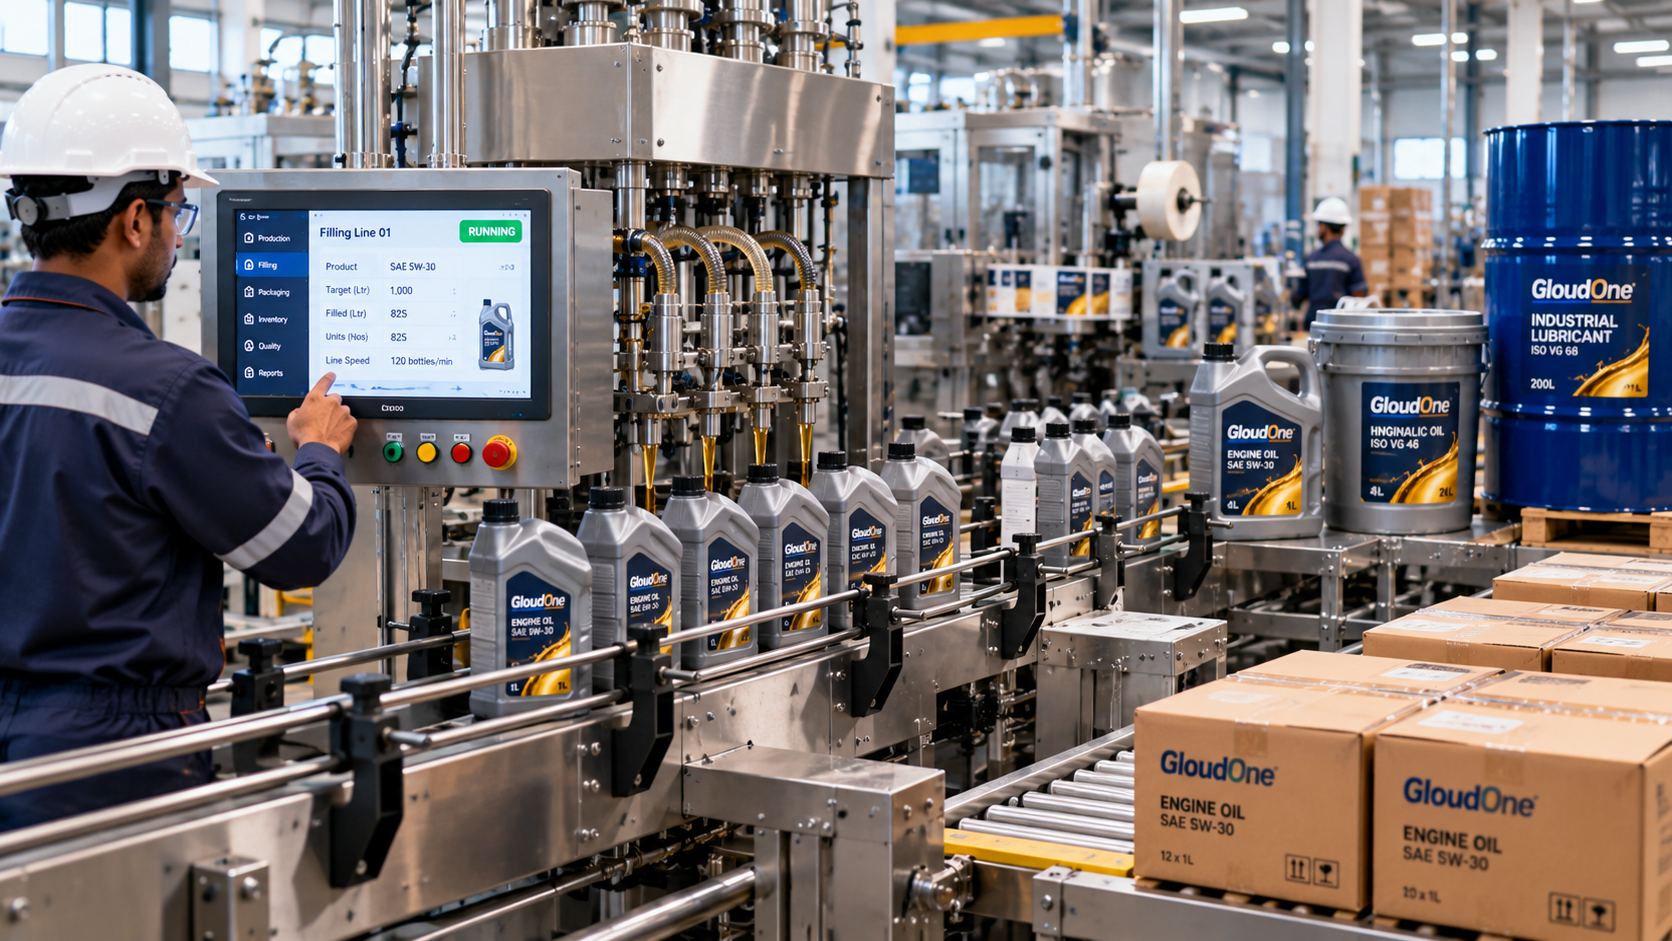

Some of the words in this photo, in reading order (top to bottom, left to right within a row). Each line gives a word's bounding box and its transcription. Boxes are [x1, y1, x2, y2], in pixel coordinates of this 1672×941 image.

[320, 227, 351, 240] Filling
[354, 227, 376, 238] Line
[378, 228, 391, 238] 01
[468, 226, 516, 237] RUNNING
[258, 234, 291, 242] Production
[258, 262, 278, 270] Filling
[326, 262, 358, 271] Product
[390, 262, 407, 270] SAE
[258, 288, 290, 297] Packaging
[326, 286, 351, 297] Target
[354, 286, 370, 296] (Ltr)
[1532, 278, 1634, 300] GloudOne
[326, 309, 347, 318] Filled
[350, 309, 366, 319] (Ltr)
[258, 316, 288, 324] Inventory
[1531, 313, 1618, 328] INDUSTRIAL
[326, 332, 346, 340] Units
[1531, 329, 1612, 343] LUBRICANT
[258, 342, 282, 351] Quality
[1531, 346, 1546, 355] ISO
[1549, 346, 1562, 356] VG
[1565, 346, 1578, 356] 68
[326, 356, 342, 364] Line
[344, 356, 370, 366] Speed
[391, 356, 406, 365] 120
[258, 370, 284, 378] Reports
[1530, 378, 1556, 390] 200L
[1370, 396, 1450, 414] GloudOne
[1227, 424, 1294, 440] GloudOne
[1430, 426, 1444, 436] OIL
[1370, 438, 1388, 448] ISO
[1390, 439, 1404, 449] VG
[1406, 440, 1420, 450] 46
[1227, 450, 1262, 459] ENGINE
[1264, 450, 1280, 459] OIL
[1227, 460, 1244, 470] SAE
[630, 572, 668, 588] GloudOne
[511, 594, 566, 608] GloudOne
[1160, 750, 1275, 786] GloudOne
[1403, 777, 1535, 818] GloudOne
[1160, 795, 1216, 816] ENGINE
[1220, 803, 1245, 820] OIL
[1160, 814, 1186, 829] SAE
[1404, 825, 1468, 850] ENGINE
[1474, 835, 1502, 854] OIL
[1160, 850, 1172, 862] 12
[1174, 854, 1180, 863] x
[1182, 854, 1194, 865] 1L
[1403, 846, 1433, 863] SAE
